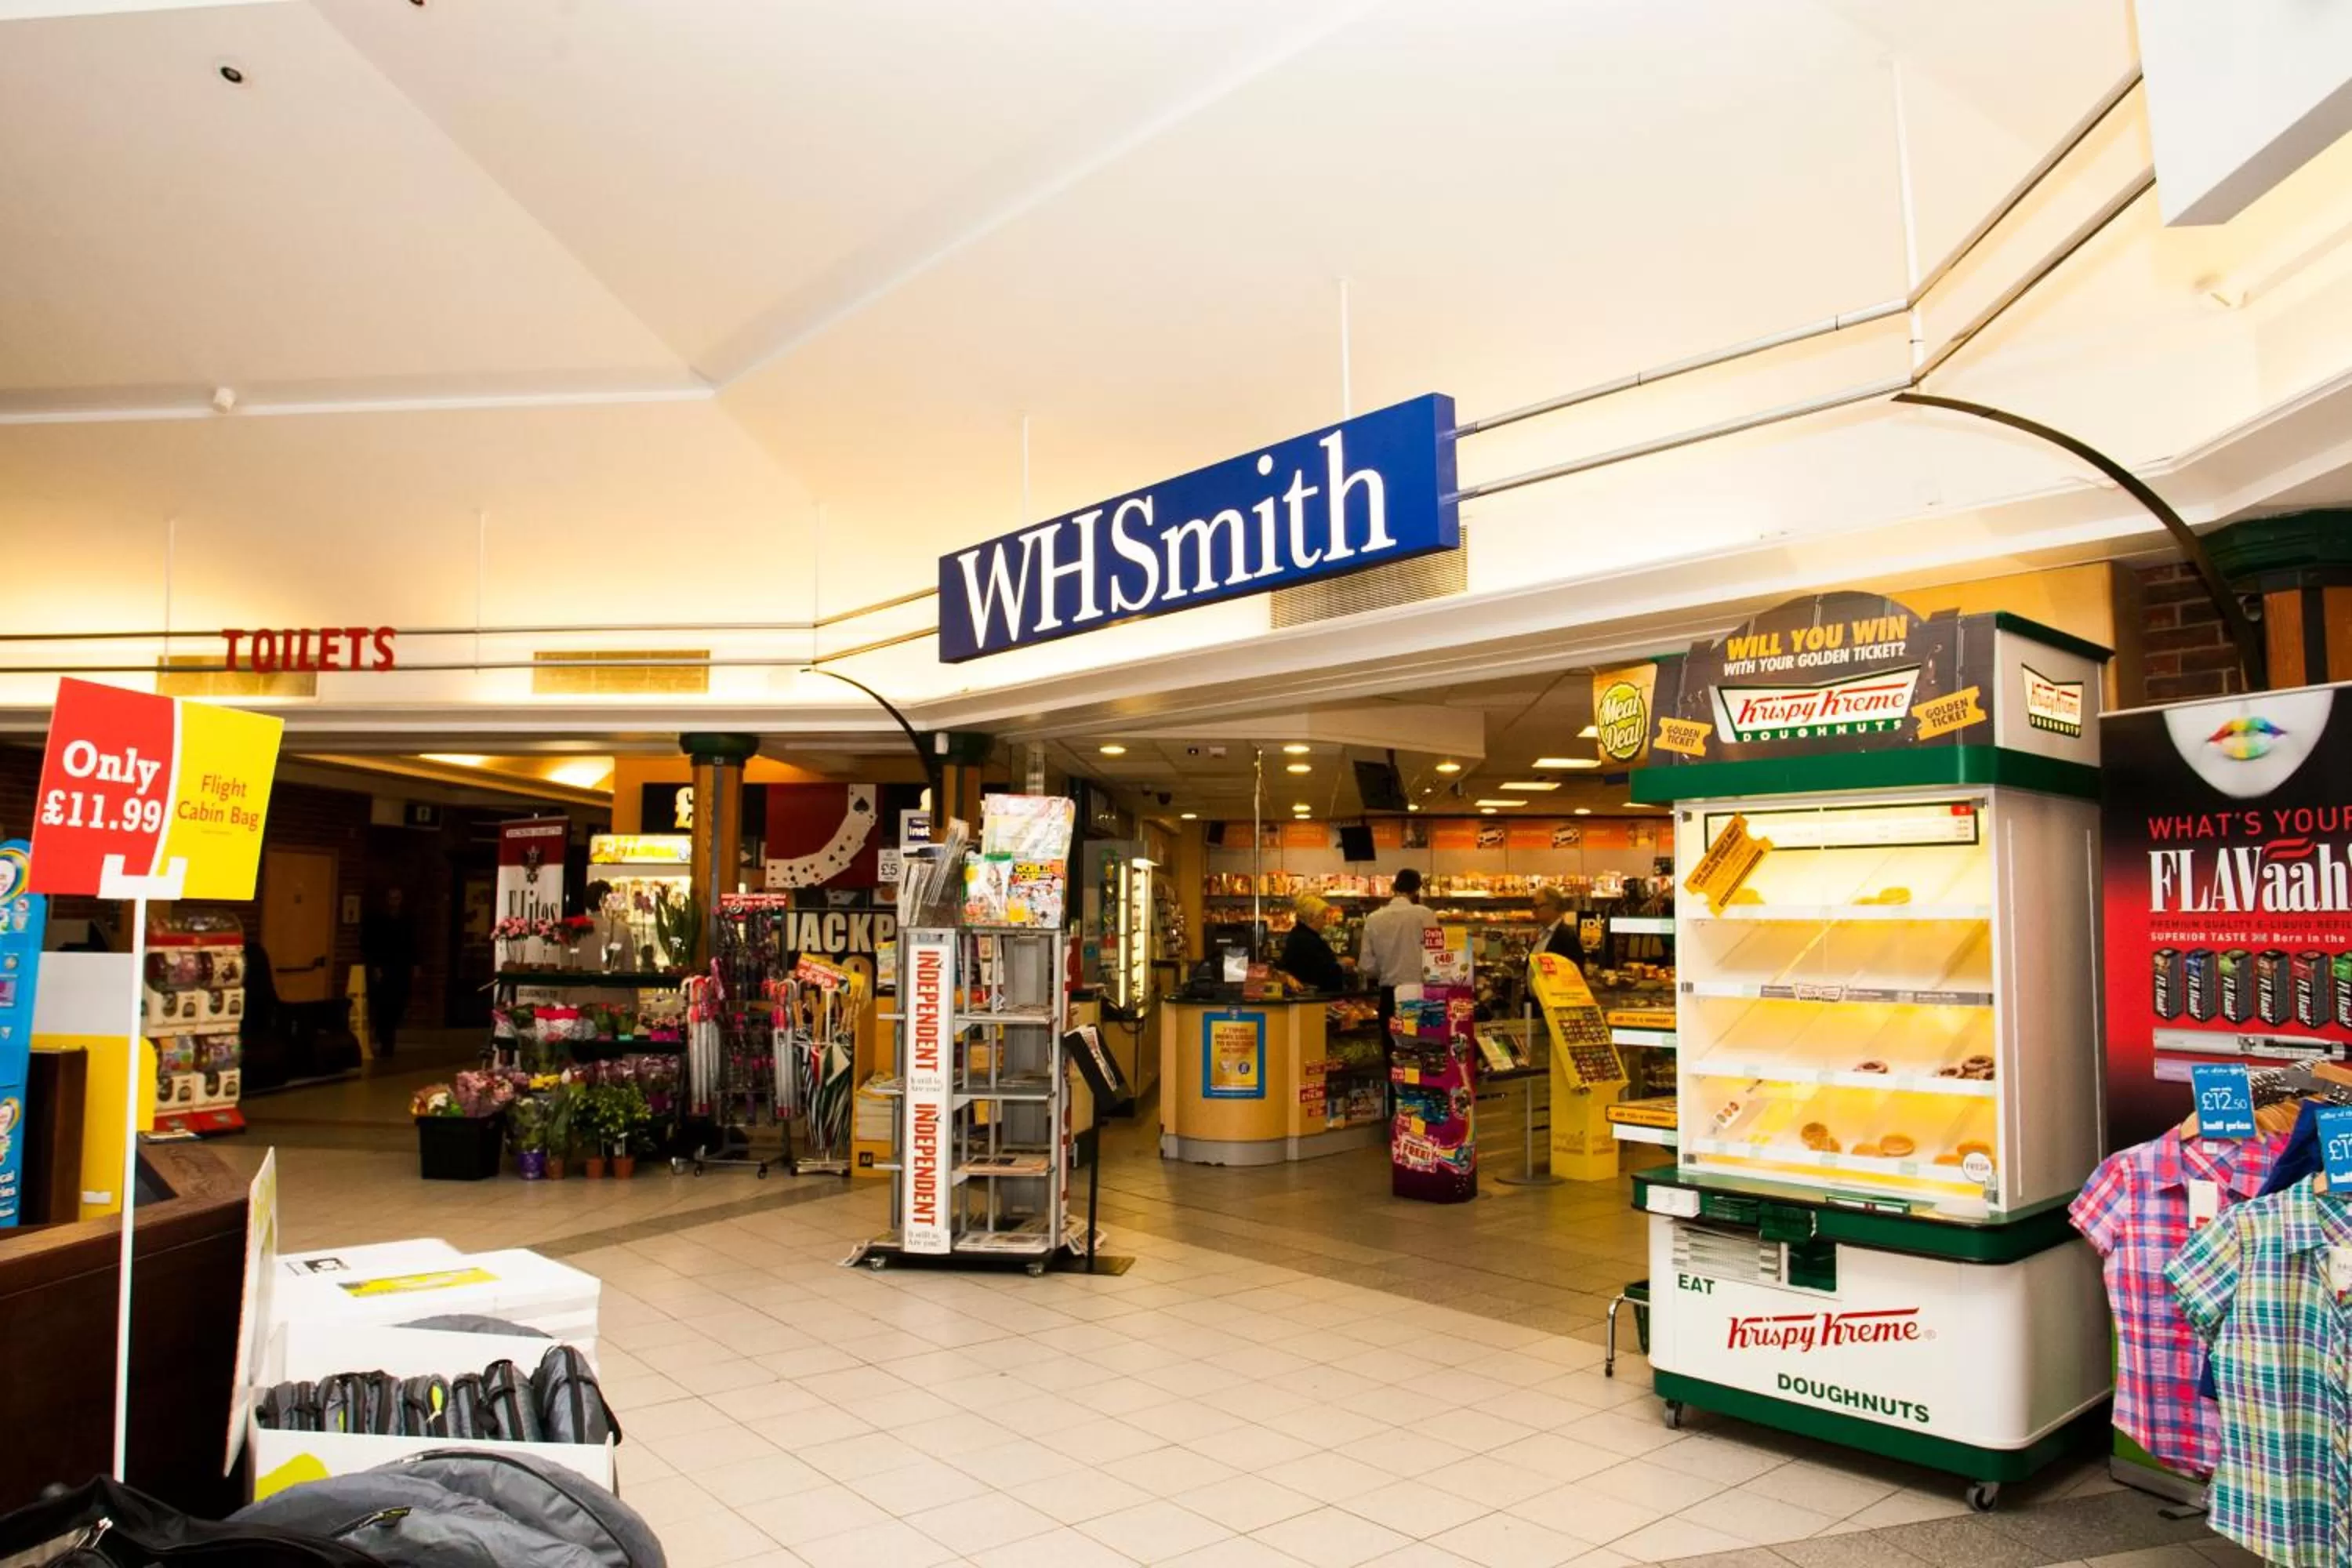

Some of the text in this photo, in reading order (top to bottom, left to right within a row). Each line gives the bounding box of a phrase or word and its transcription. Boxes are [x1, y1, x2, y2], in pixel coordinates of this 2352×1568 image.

[958, 430, 1396, 650] WHSmith
[221, 626, 397, 673] TOILETS
[1727, 615, 1908, 661] WILL YOU WIN
[1723, 641, 1906, 677] WITH YOUR GOLDEN TICKET?
[1602, 689, 1641, 725] Meal
[1737, 683, 1908, 724] Krispy Kreme
[1926, 696, 1969, 719] GOLDEN
[1932, 708, 1968, 728] TICKET
[1606, 718, 1641, 753] Deal
[1667, 725, 1700, 739] GOLDEN
[1668, 734, 1696, 748] TICKET
[1743, 719, 1902, 742] DOUGHNUTS
[63, 739, 162, 794] Only
[200, 775, 247, 801] Flight
[41, 789, 163, 833] £11.99
[177, 799, 260, 833] Cabin Bag
[2148, 811, 2262, 840] WHAT'S
[880, 862, 898, 876] £5
[2150, 931, 2206, 942] SUPERIOR
[2210, 931, 2247, 942] TASTE
[2205, 919, 2252, 929] QUALITY
[915, 950, 940, 1073] INDEPENDENT
[913, 1103, 938, 1227] INDEPENDENT
[1678, 1273, 1715, 1296] EAT
[1727, 1307, 1920, 1354] Krispy Kreme
[1777, 1373, 1930, 1424] DOUGHNUTS
